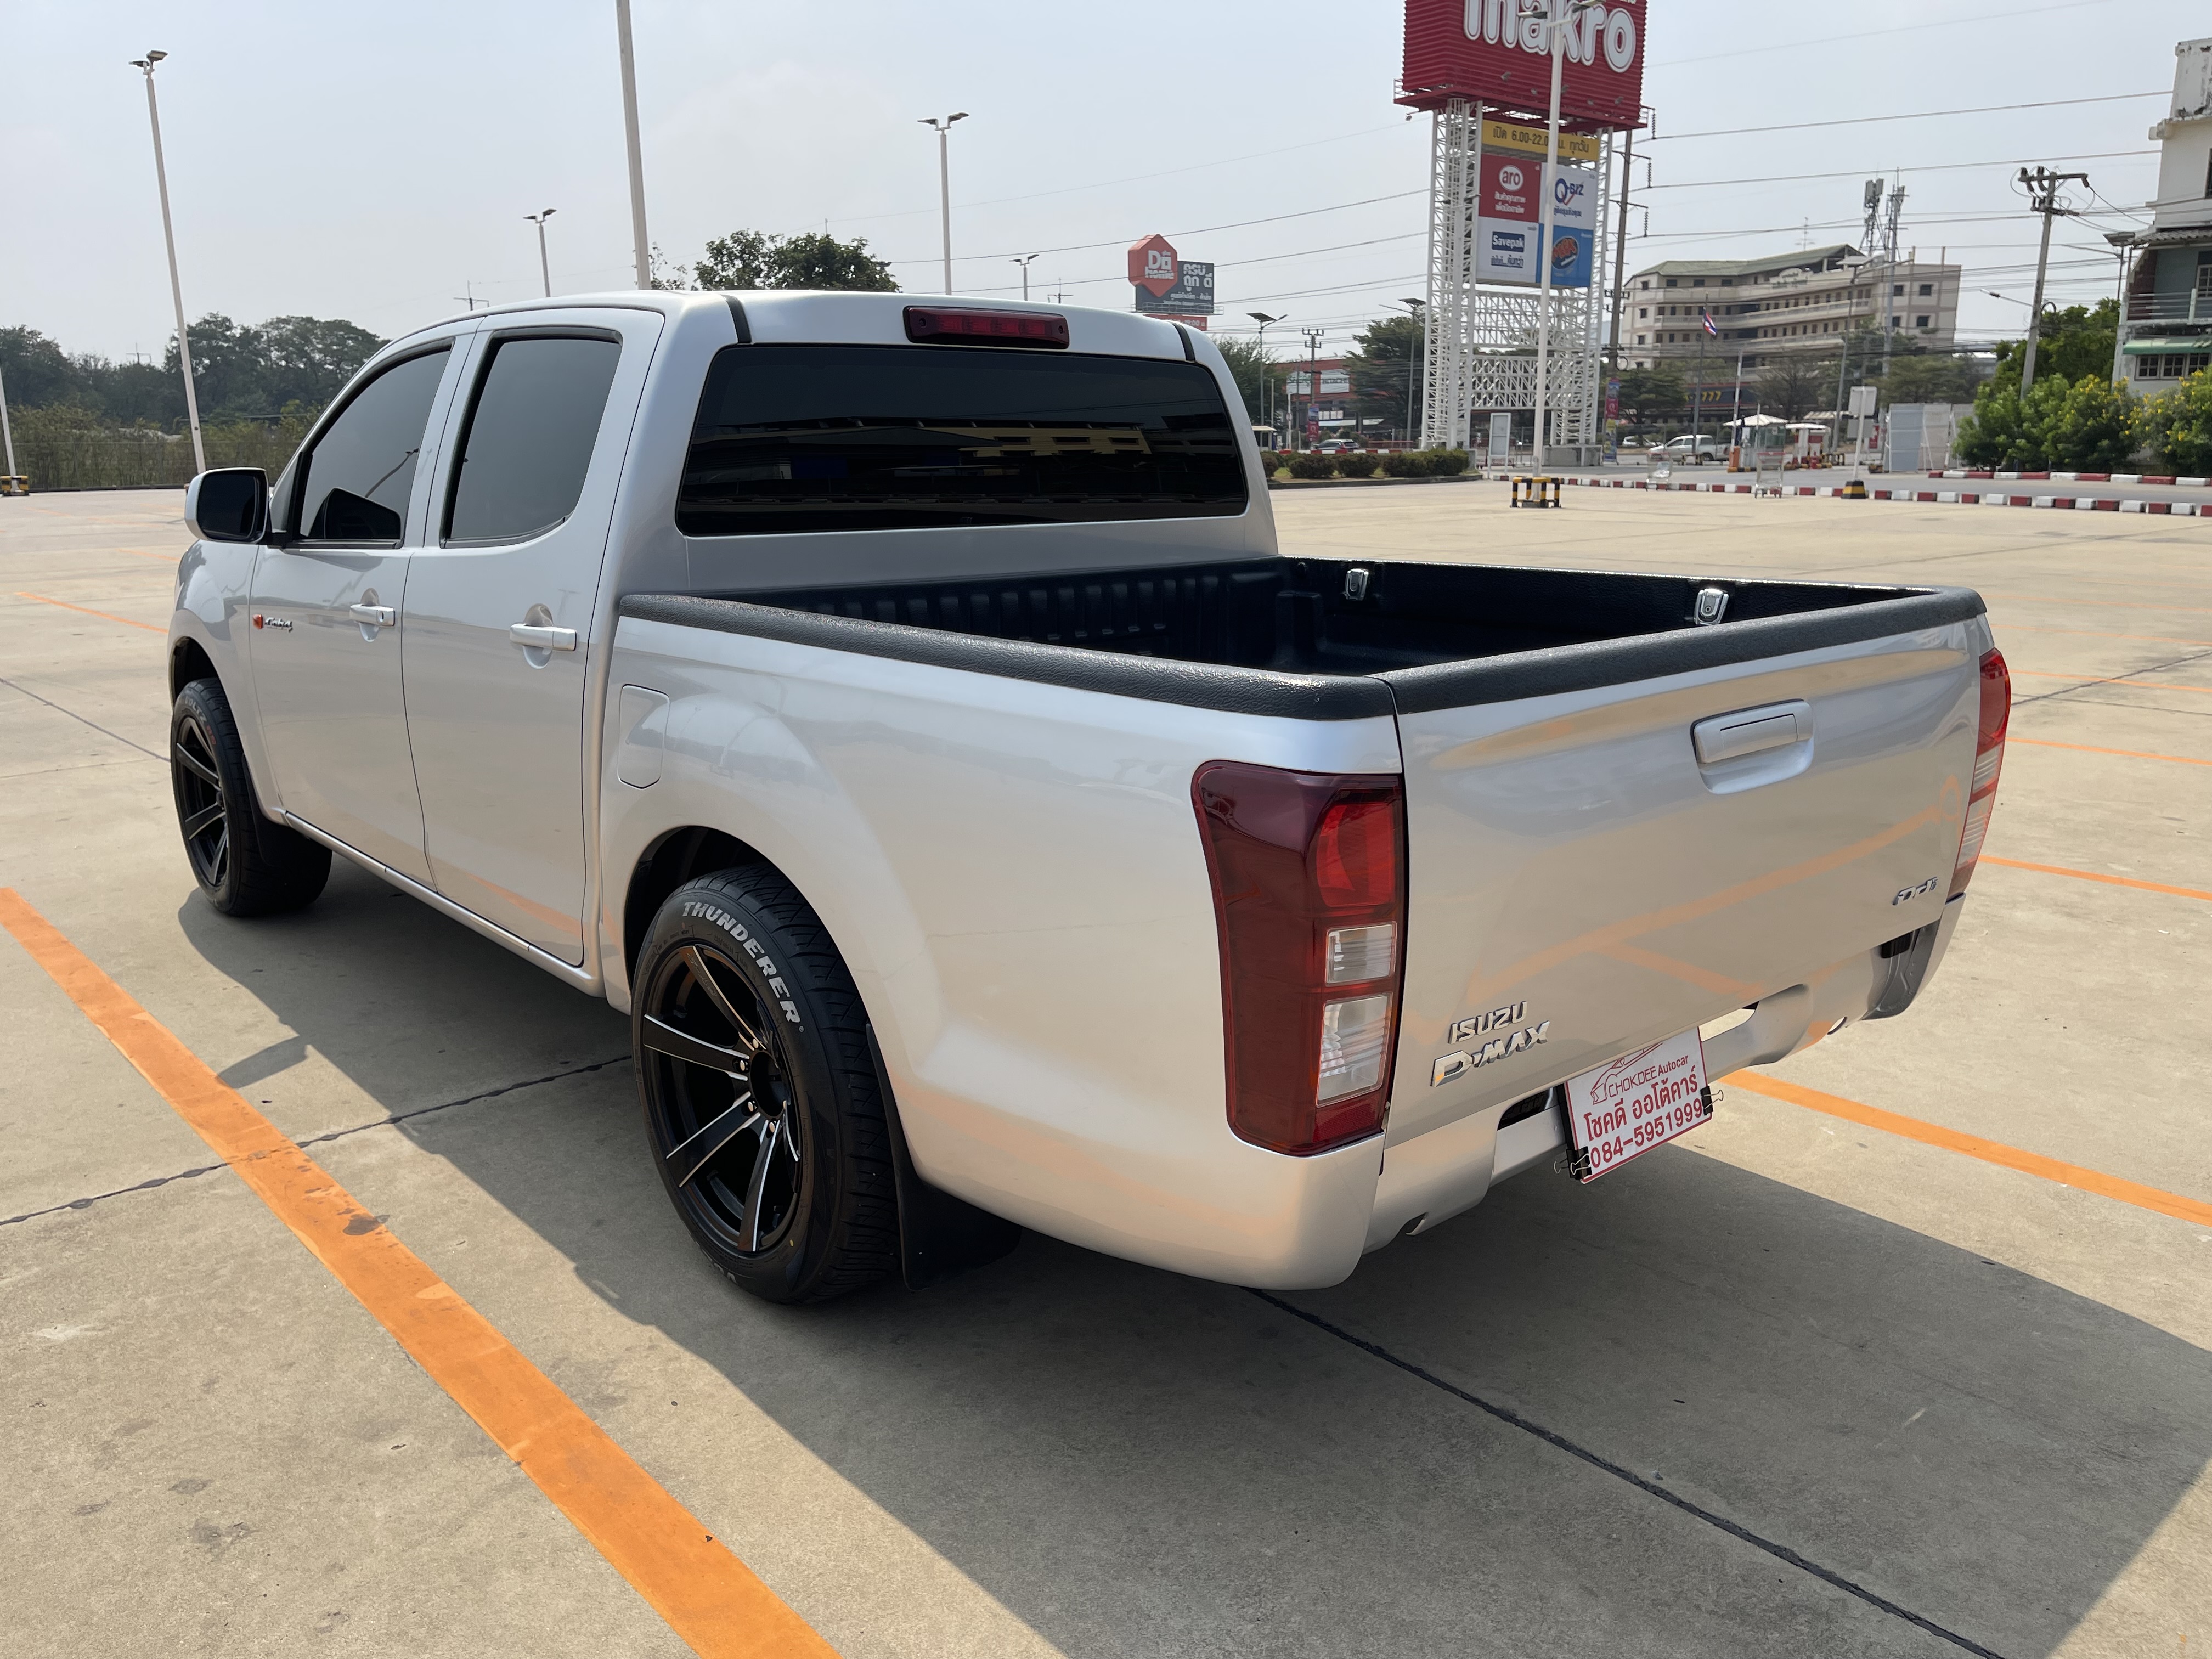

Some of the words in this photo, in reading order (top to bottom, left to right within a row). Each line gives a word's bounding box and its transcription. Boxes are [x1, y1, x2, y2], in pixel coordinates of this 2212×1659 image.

[1464, 0, 1636, 73] makro
[1511, 130, 1549, 146] 6.00-22.0
[1502, 171, 1521, 185] aro
[1492, 235, 1524, 249] Savepak
[1145, 266, 1175, 280] home
[682, 901, 801, 1023] THUNDERER
[1448, 1001, 1527, 1045] ISUZU
[1430, 1020, 1550, 1088] D-MAX
[1608, 1066, 1657, 1098] CHOKDEE
[1658, 1055, 1689, 1077] Autocar
[1583, 1097, 1627, 1142] โชคดี
[1632, 1064, 1698, 1120] ออโต้คาร์
[1590, 1098, 1702, 1168] 084-5951999
